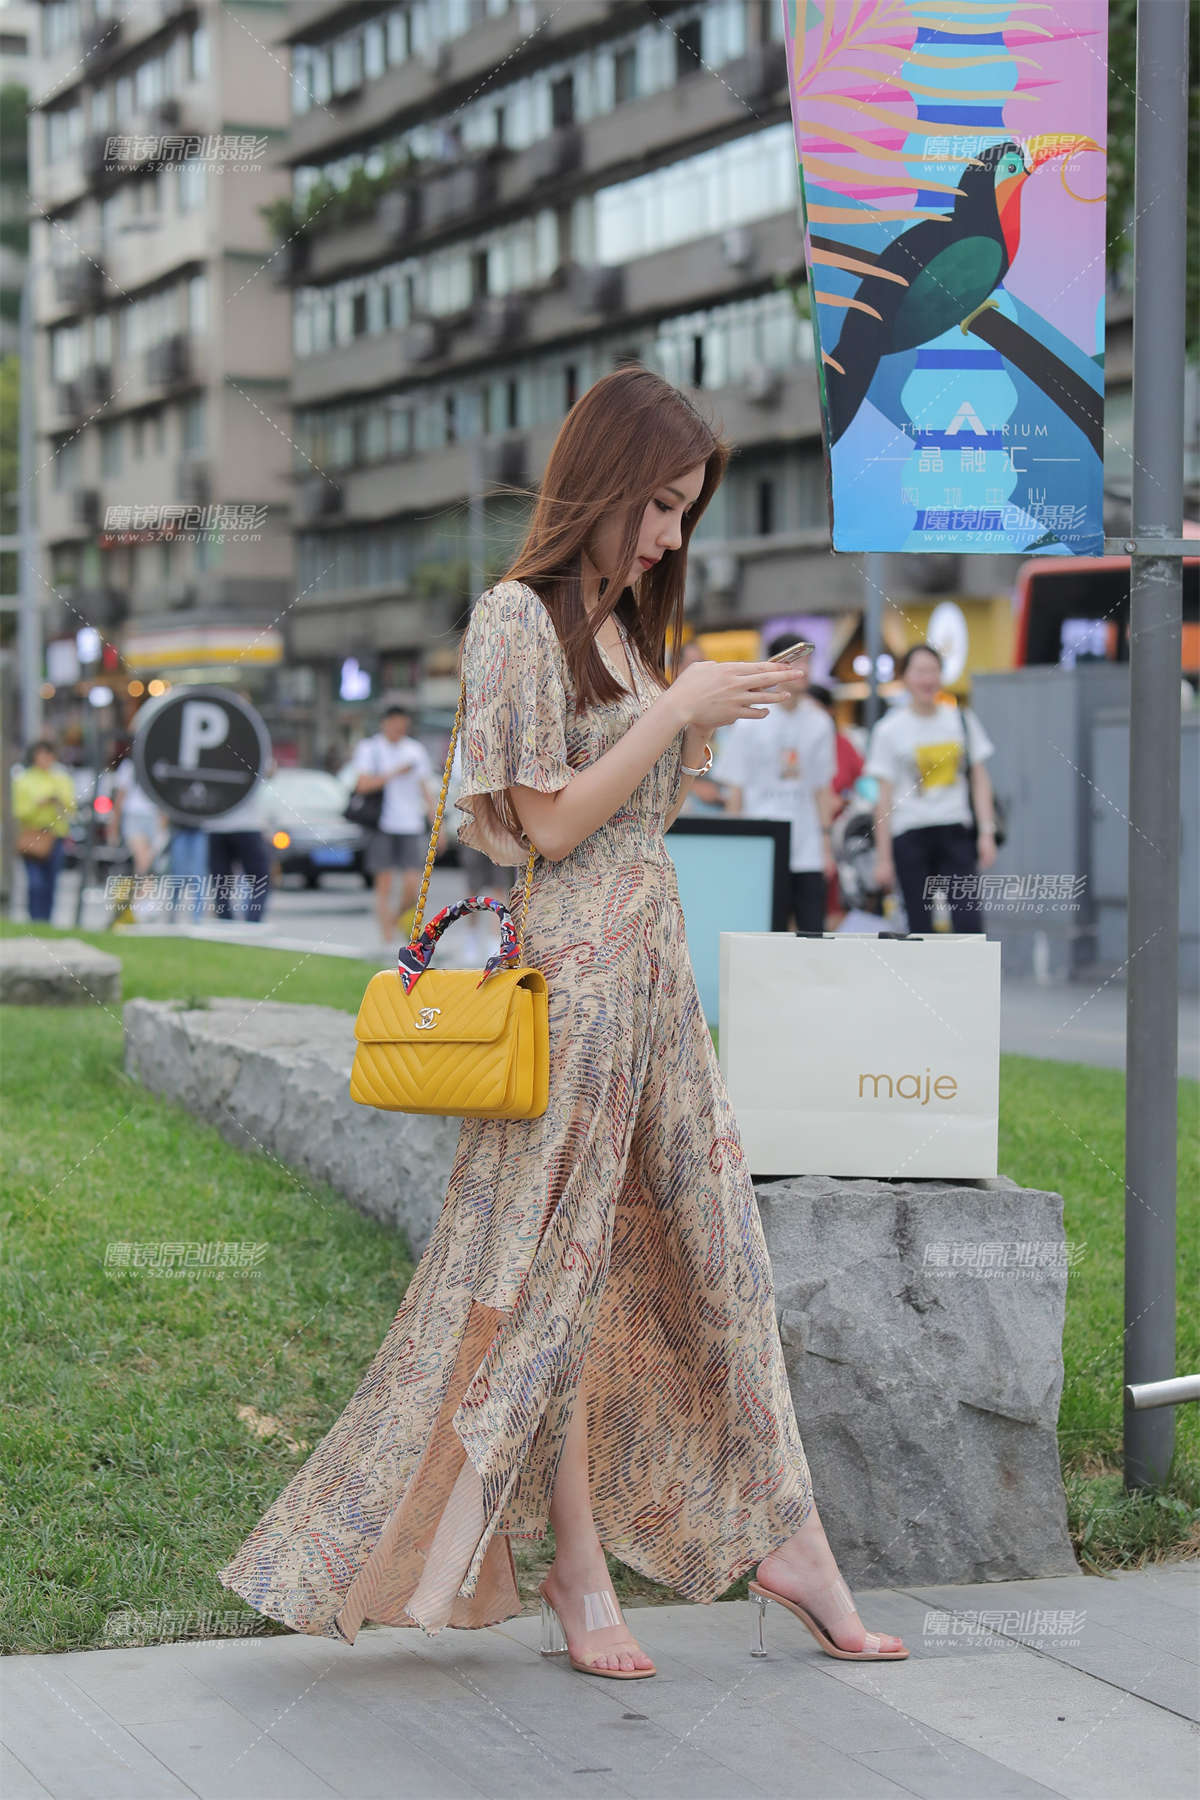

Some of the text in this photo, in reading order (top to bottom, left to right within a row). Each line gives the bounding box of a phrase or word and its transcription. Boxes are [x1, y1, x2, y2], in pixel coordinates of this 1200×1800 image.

[900, 423, 934, 437] THE
[178, 701, 230, 770] P
[858, 1067, 958, 1106] maje
